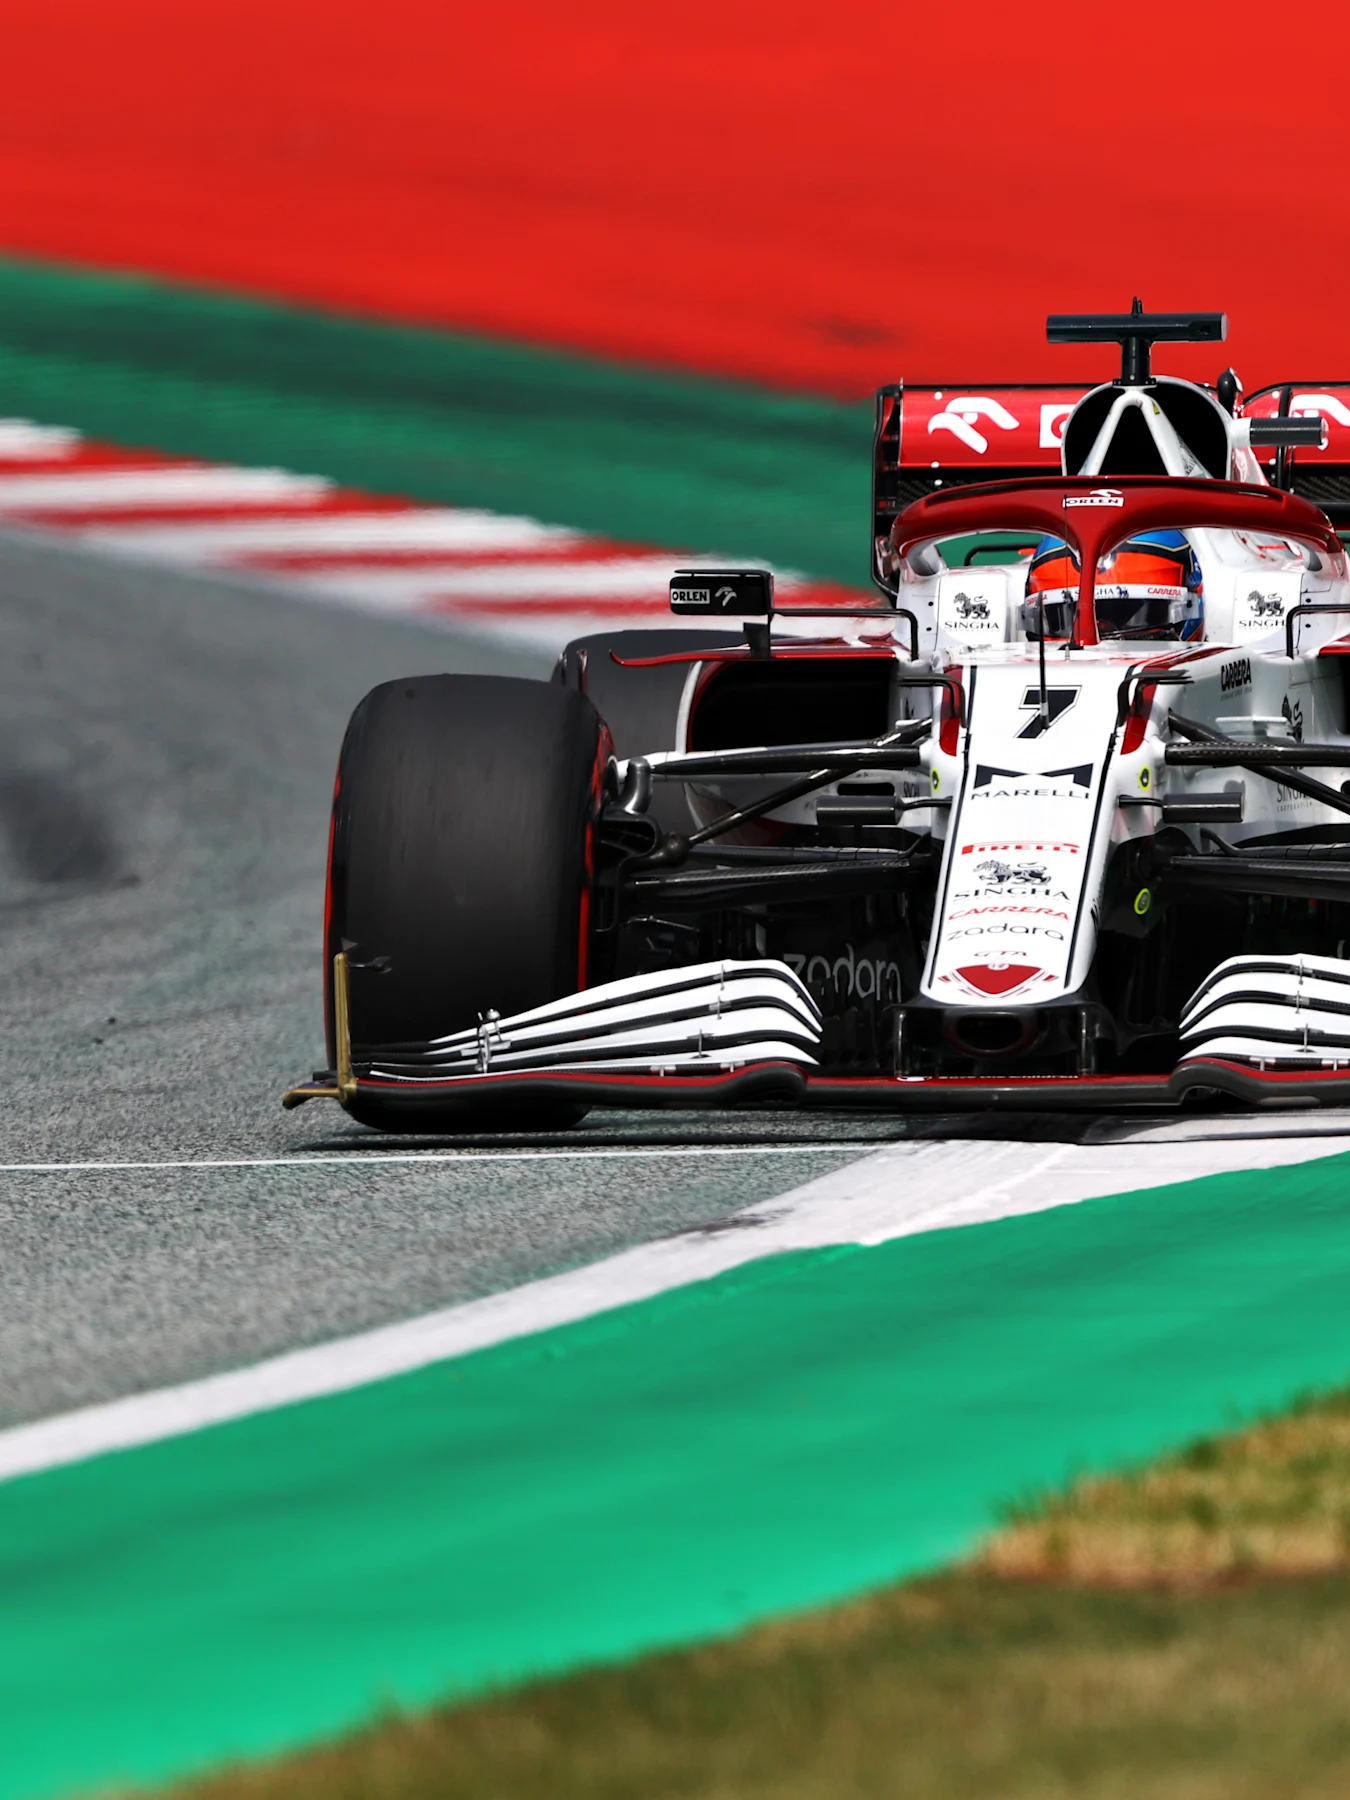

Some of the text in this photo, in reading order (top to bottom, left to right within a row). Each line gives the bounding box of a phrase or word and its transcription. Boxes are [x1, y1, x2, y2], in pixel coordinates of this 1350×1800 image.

[672, 590, 708, 602] ORLEN
[1147, 586, 1182, 597] CARRERA
[944, 620, 1000, 630] SINGHA
[1238, 619, 1287, 628] SINGH
[1220, 656, 1252, 692] CARRERA
[1012, 684, 1083, 739] 7
[970, 788, 1091, 801] MARELLI
[960, 839, 1081, 856] PIRELLI
[953, 886, 1071, 901] SINGHA
[947, 905, 1070, 921] CARRERA
[946, 922, 1065, 942] zadara
